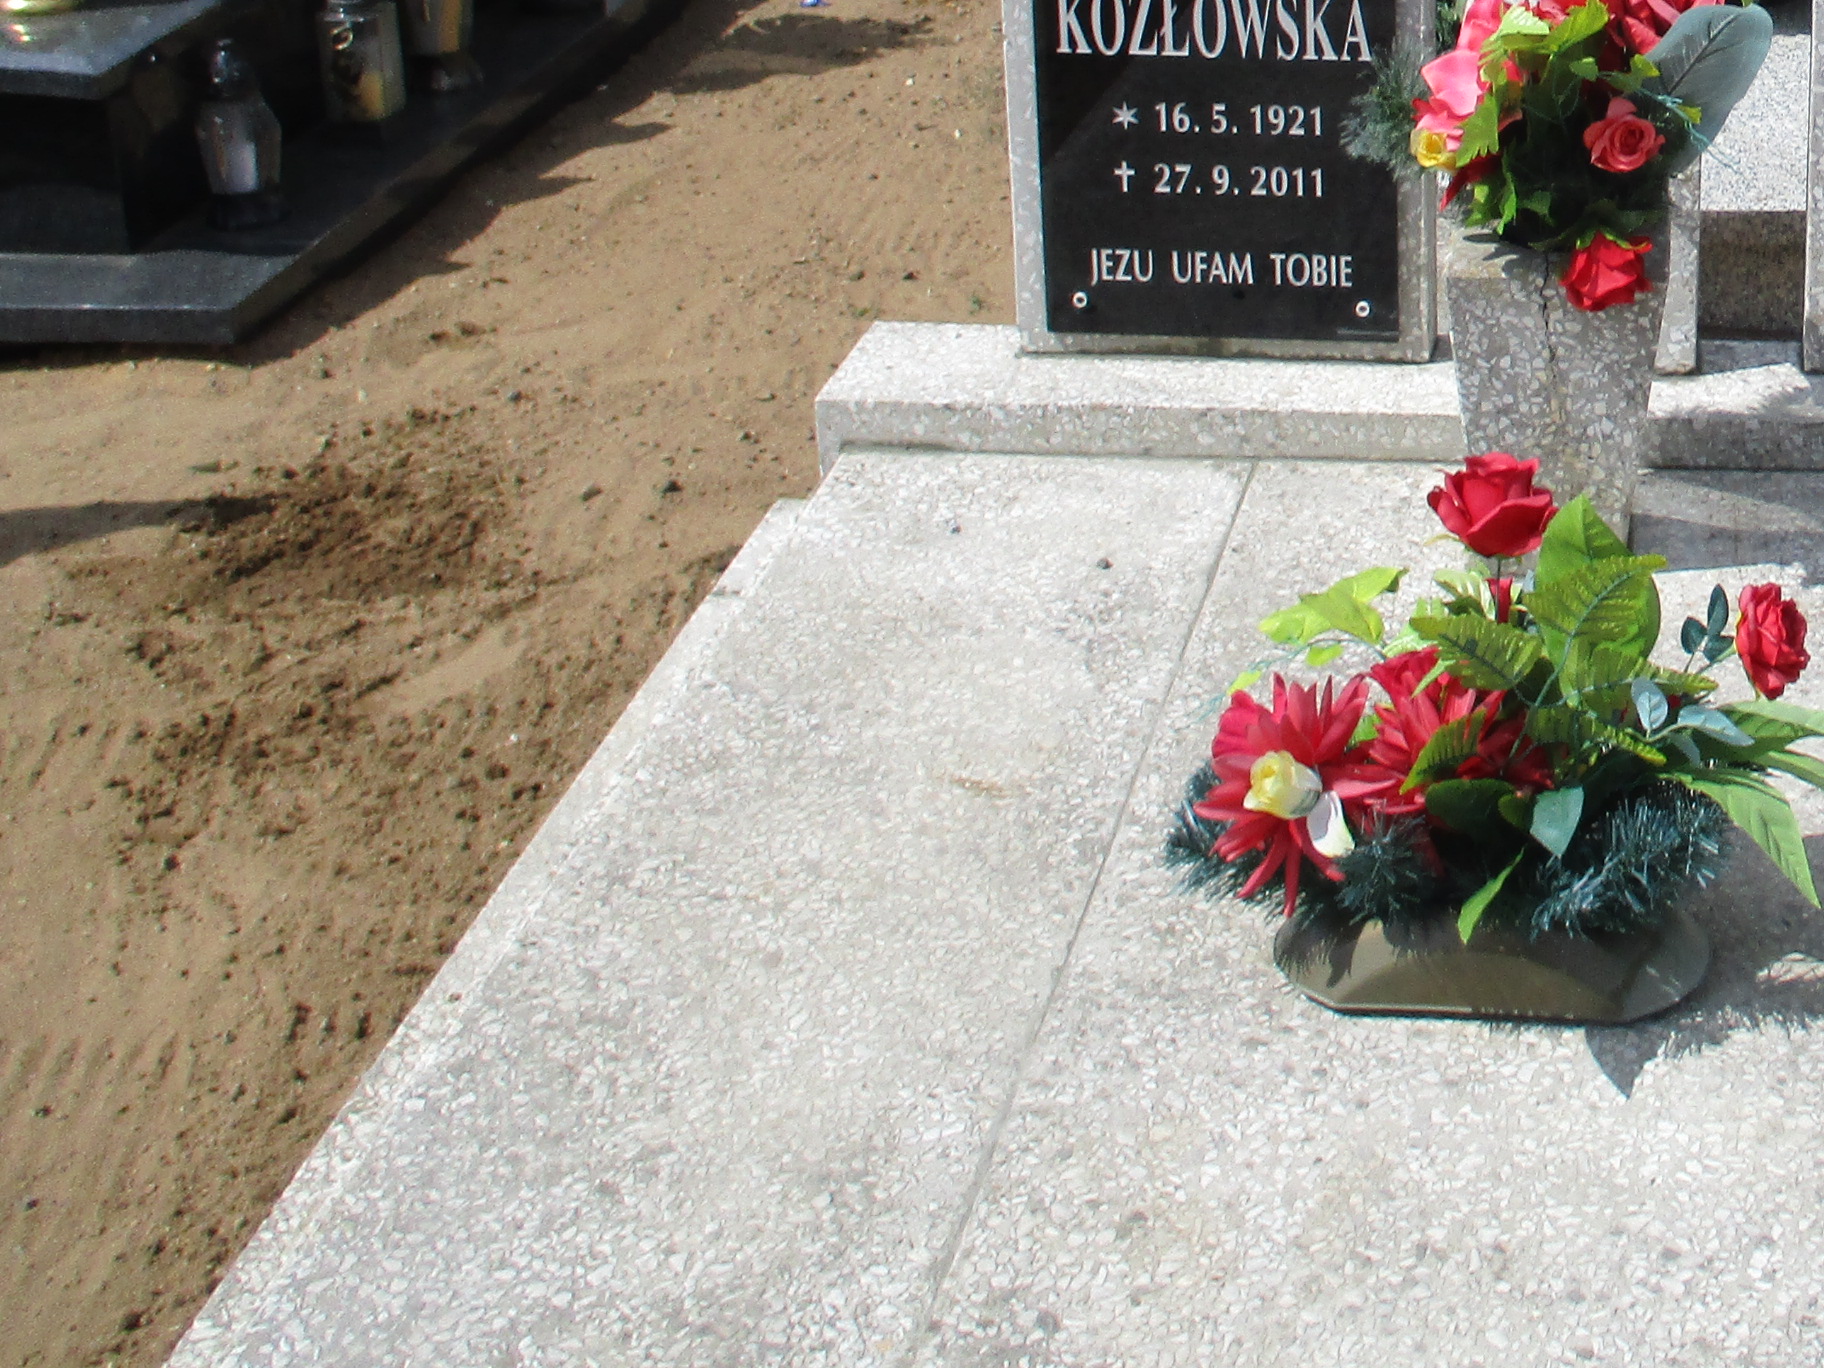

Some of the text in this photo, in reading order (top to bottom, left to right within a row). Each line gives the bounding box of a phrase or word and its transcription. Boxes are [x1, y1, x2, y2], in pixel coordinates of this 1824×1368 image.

[1090, 248, 1353, 289] JEZU UFAM TOBIE
